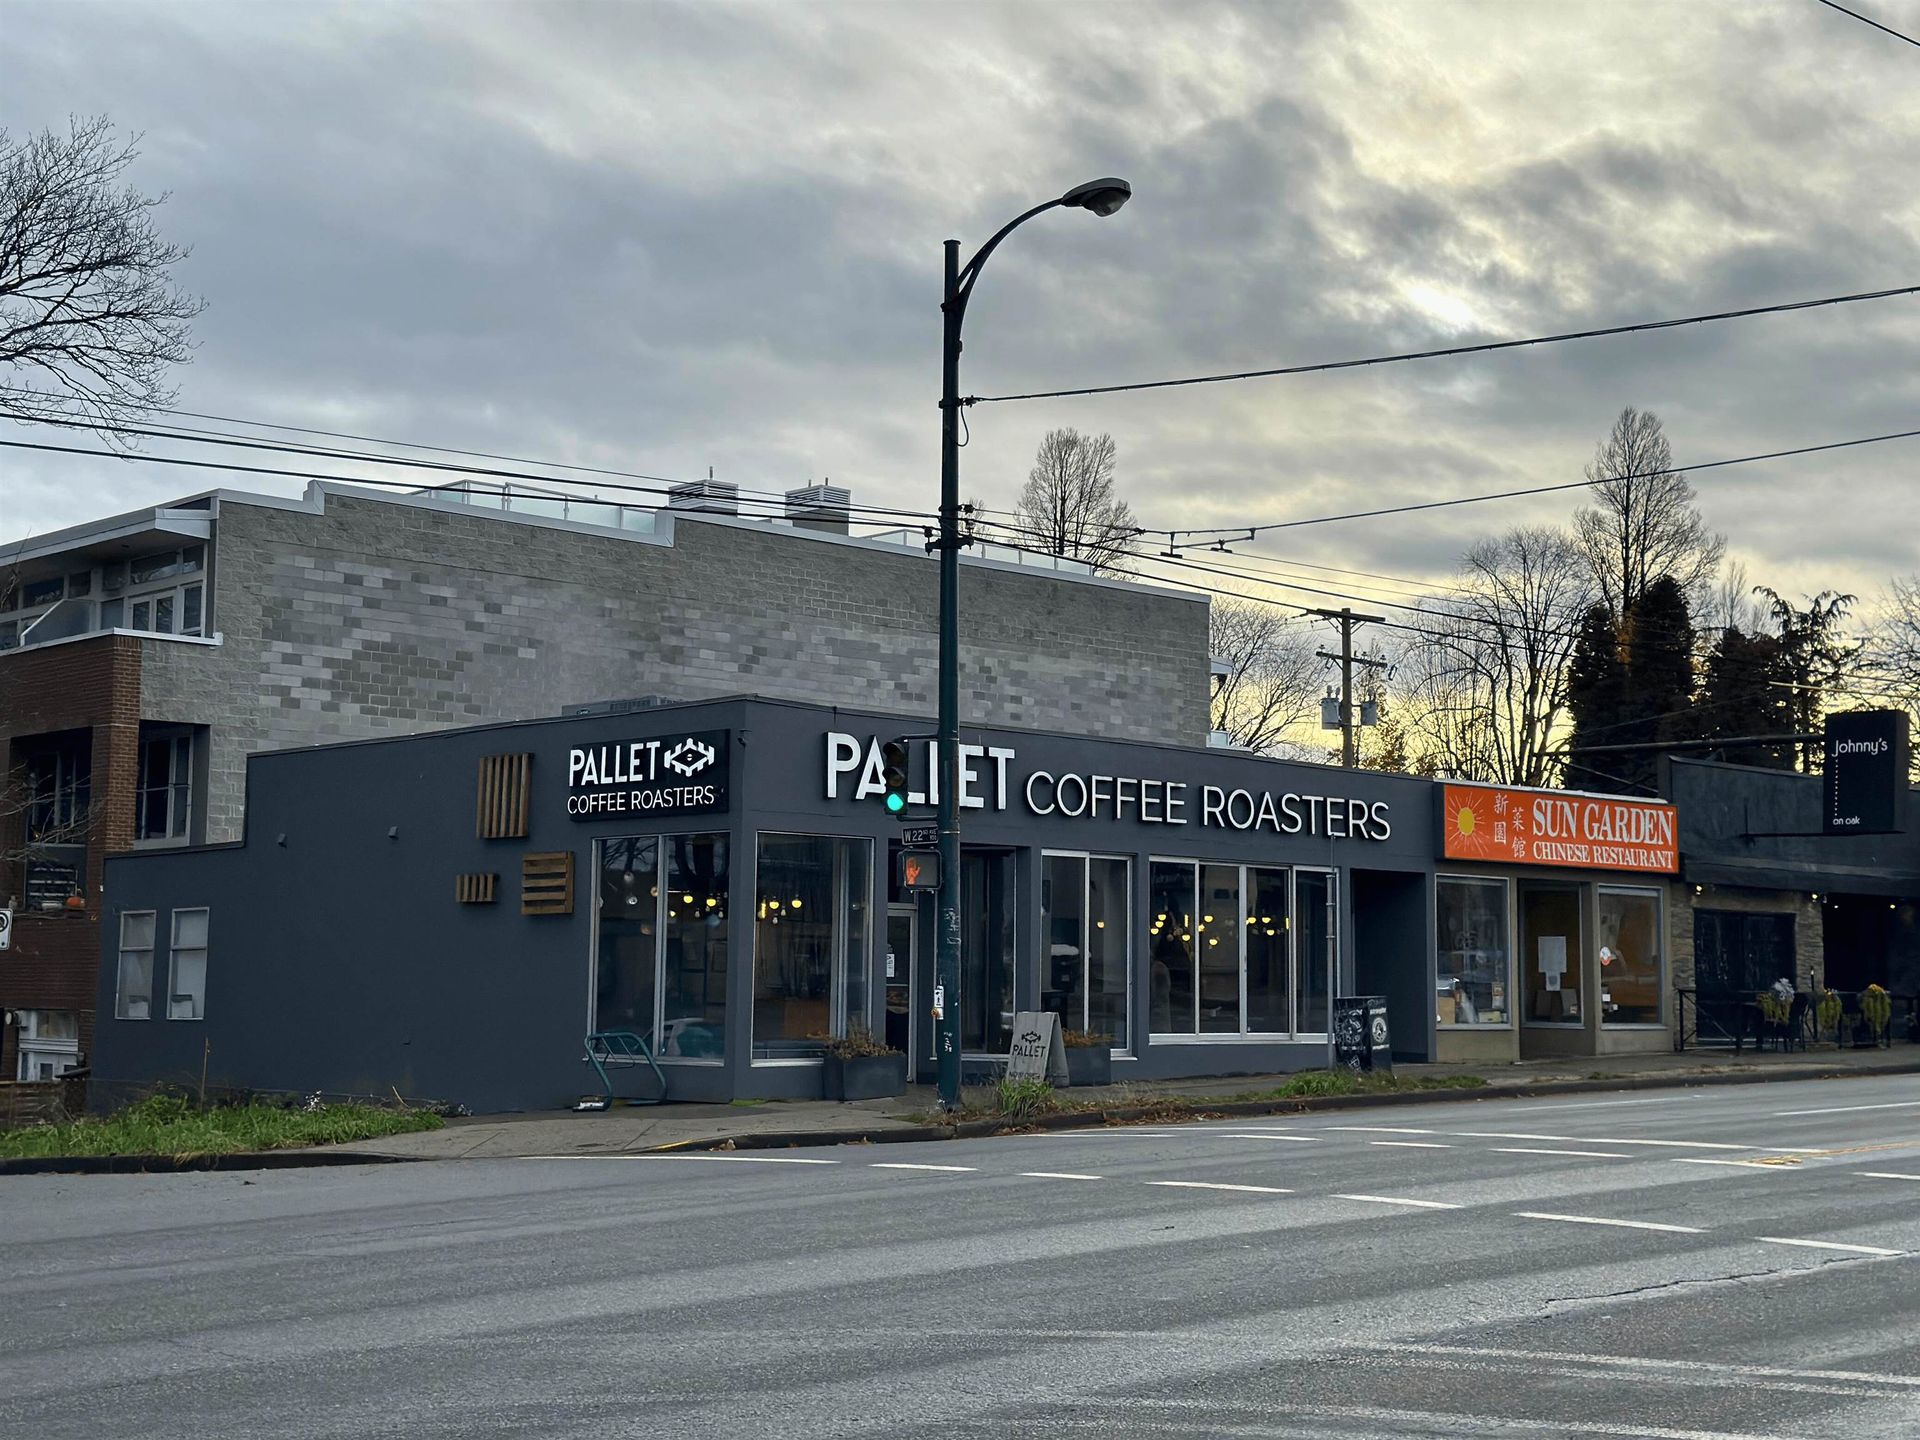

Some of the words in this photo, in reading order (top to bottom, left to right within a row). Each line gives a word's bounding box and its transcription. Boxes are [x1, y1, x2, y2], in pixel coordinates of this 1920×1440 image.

[1831, 738, 1888, 757] Johnny's
[569, 741, 661, 787] PALLET
[567, 792, 626, 814] COFFEE
[631, 785, 715, 810] ROASTERS
[1026, 771, 1187, 824] COFFEE
[1203, 785, 1391, 841] ROASTERS
[1532, 798, 1580, 838] SUN
[1584, 803, 1674, 846] GARDEN
[1845, 816, 1861, 825] oak
[904, 830, 911, 842] W
[1533, 841, 1590, 863] CHINESE
[1593, 846, 1674, 868] RESTAURANT
[1012, 1044, 1046, 1057] PALLET
